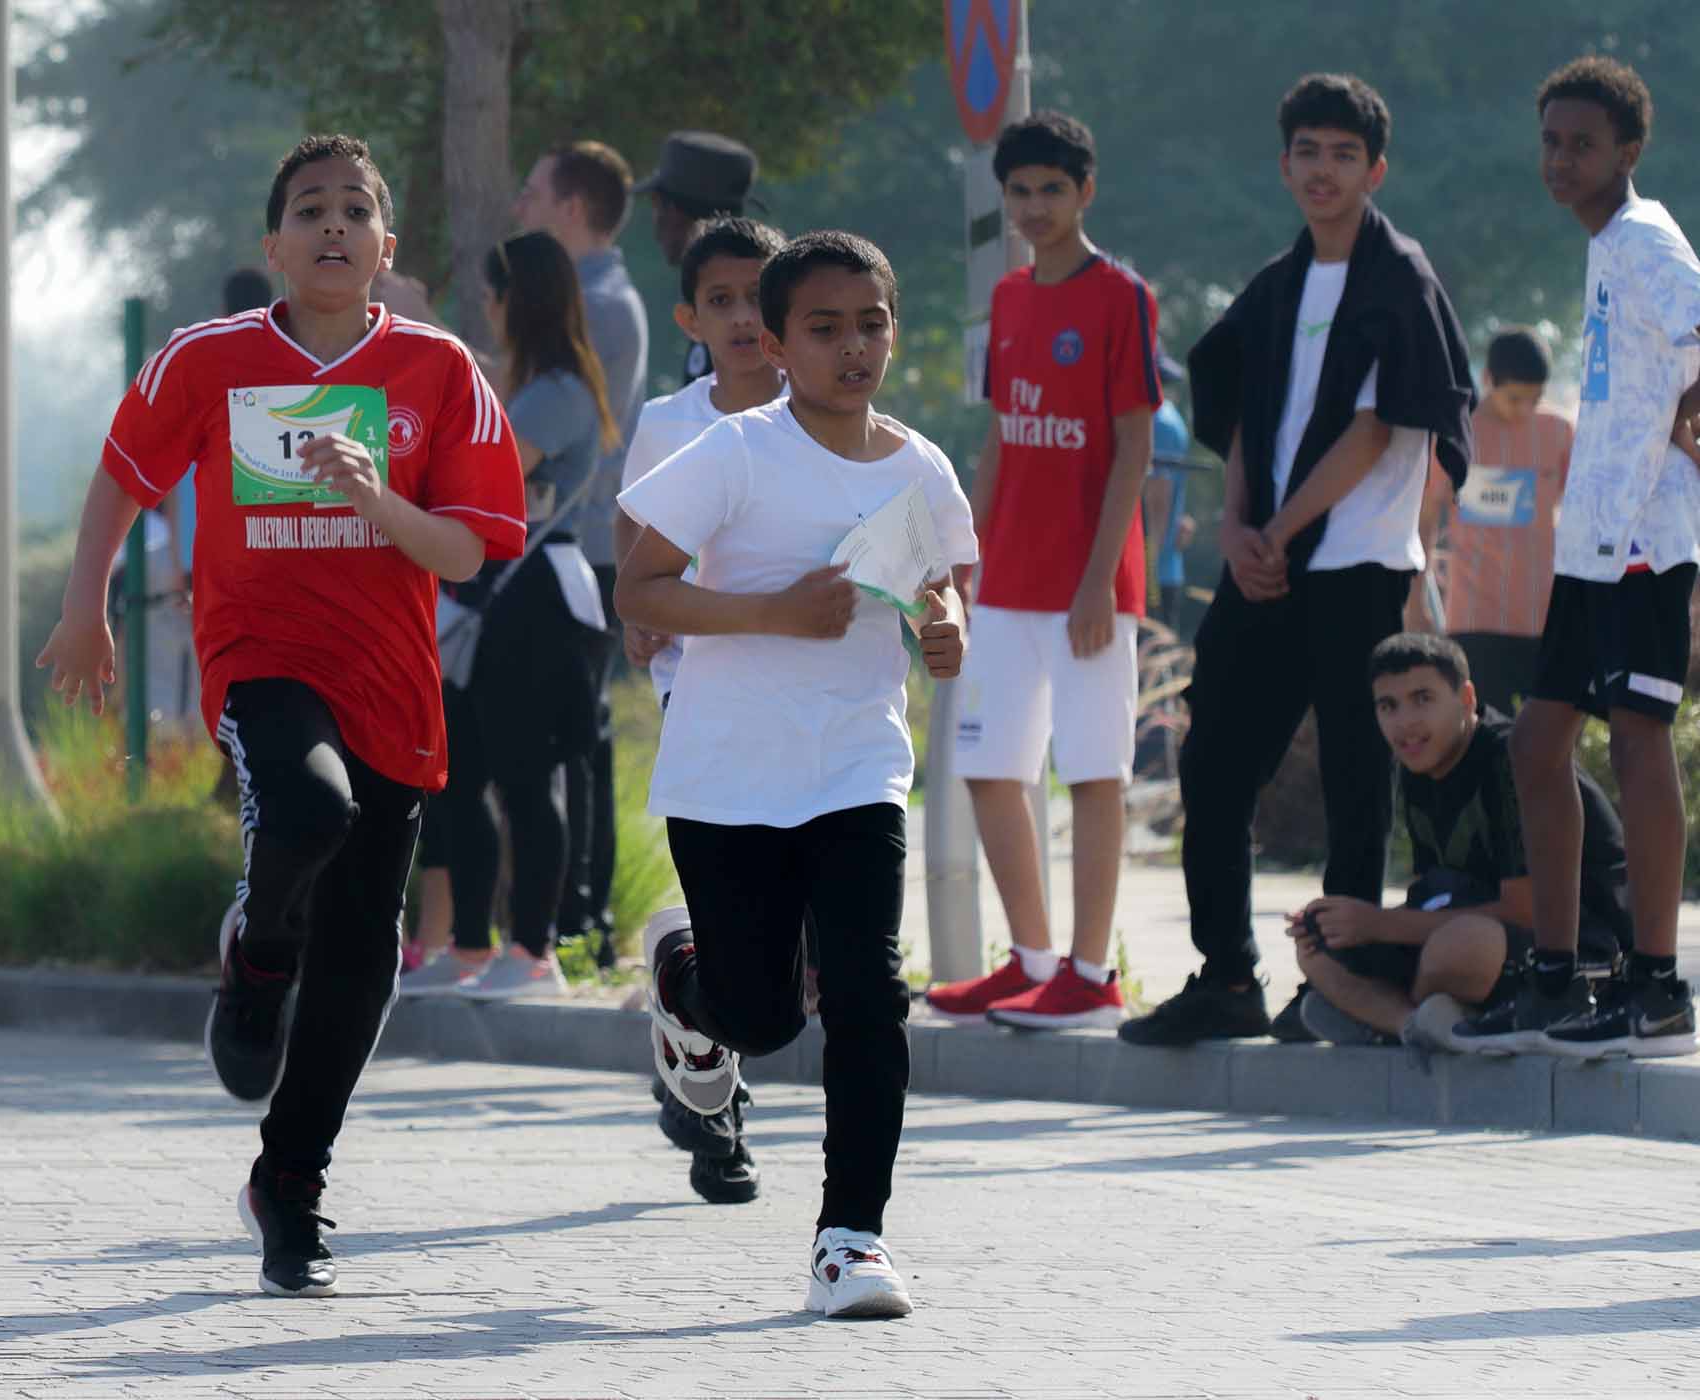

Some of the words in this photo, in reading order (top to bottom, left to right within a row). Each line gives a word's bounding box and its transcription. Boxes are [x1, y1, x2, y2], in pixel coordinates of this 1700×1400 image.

[1010, 377, 1042, 413] Fly
[365, 426, 376, 441] 1
[245, 516, 300, 548] VOLLEYBALL
[301, 516, 370, 548] DEVELOPMENT
